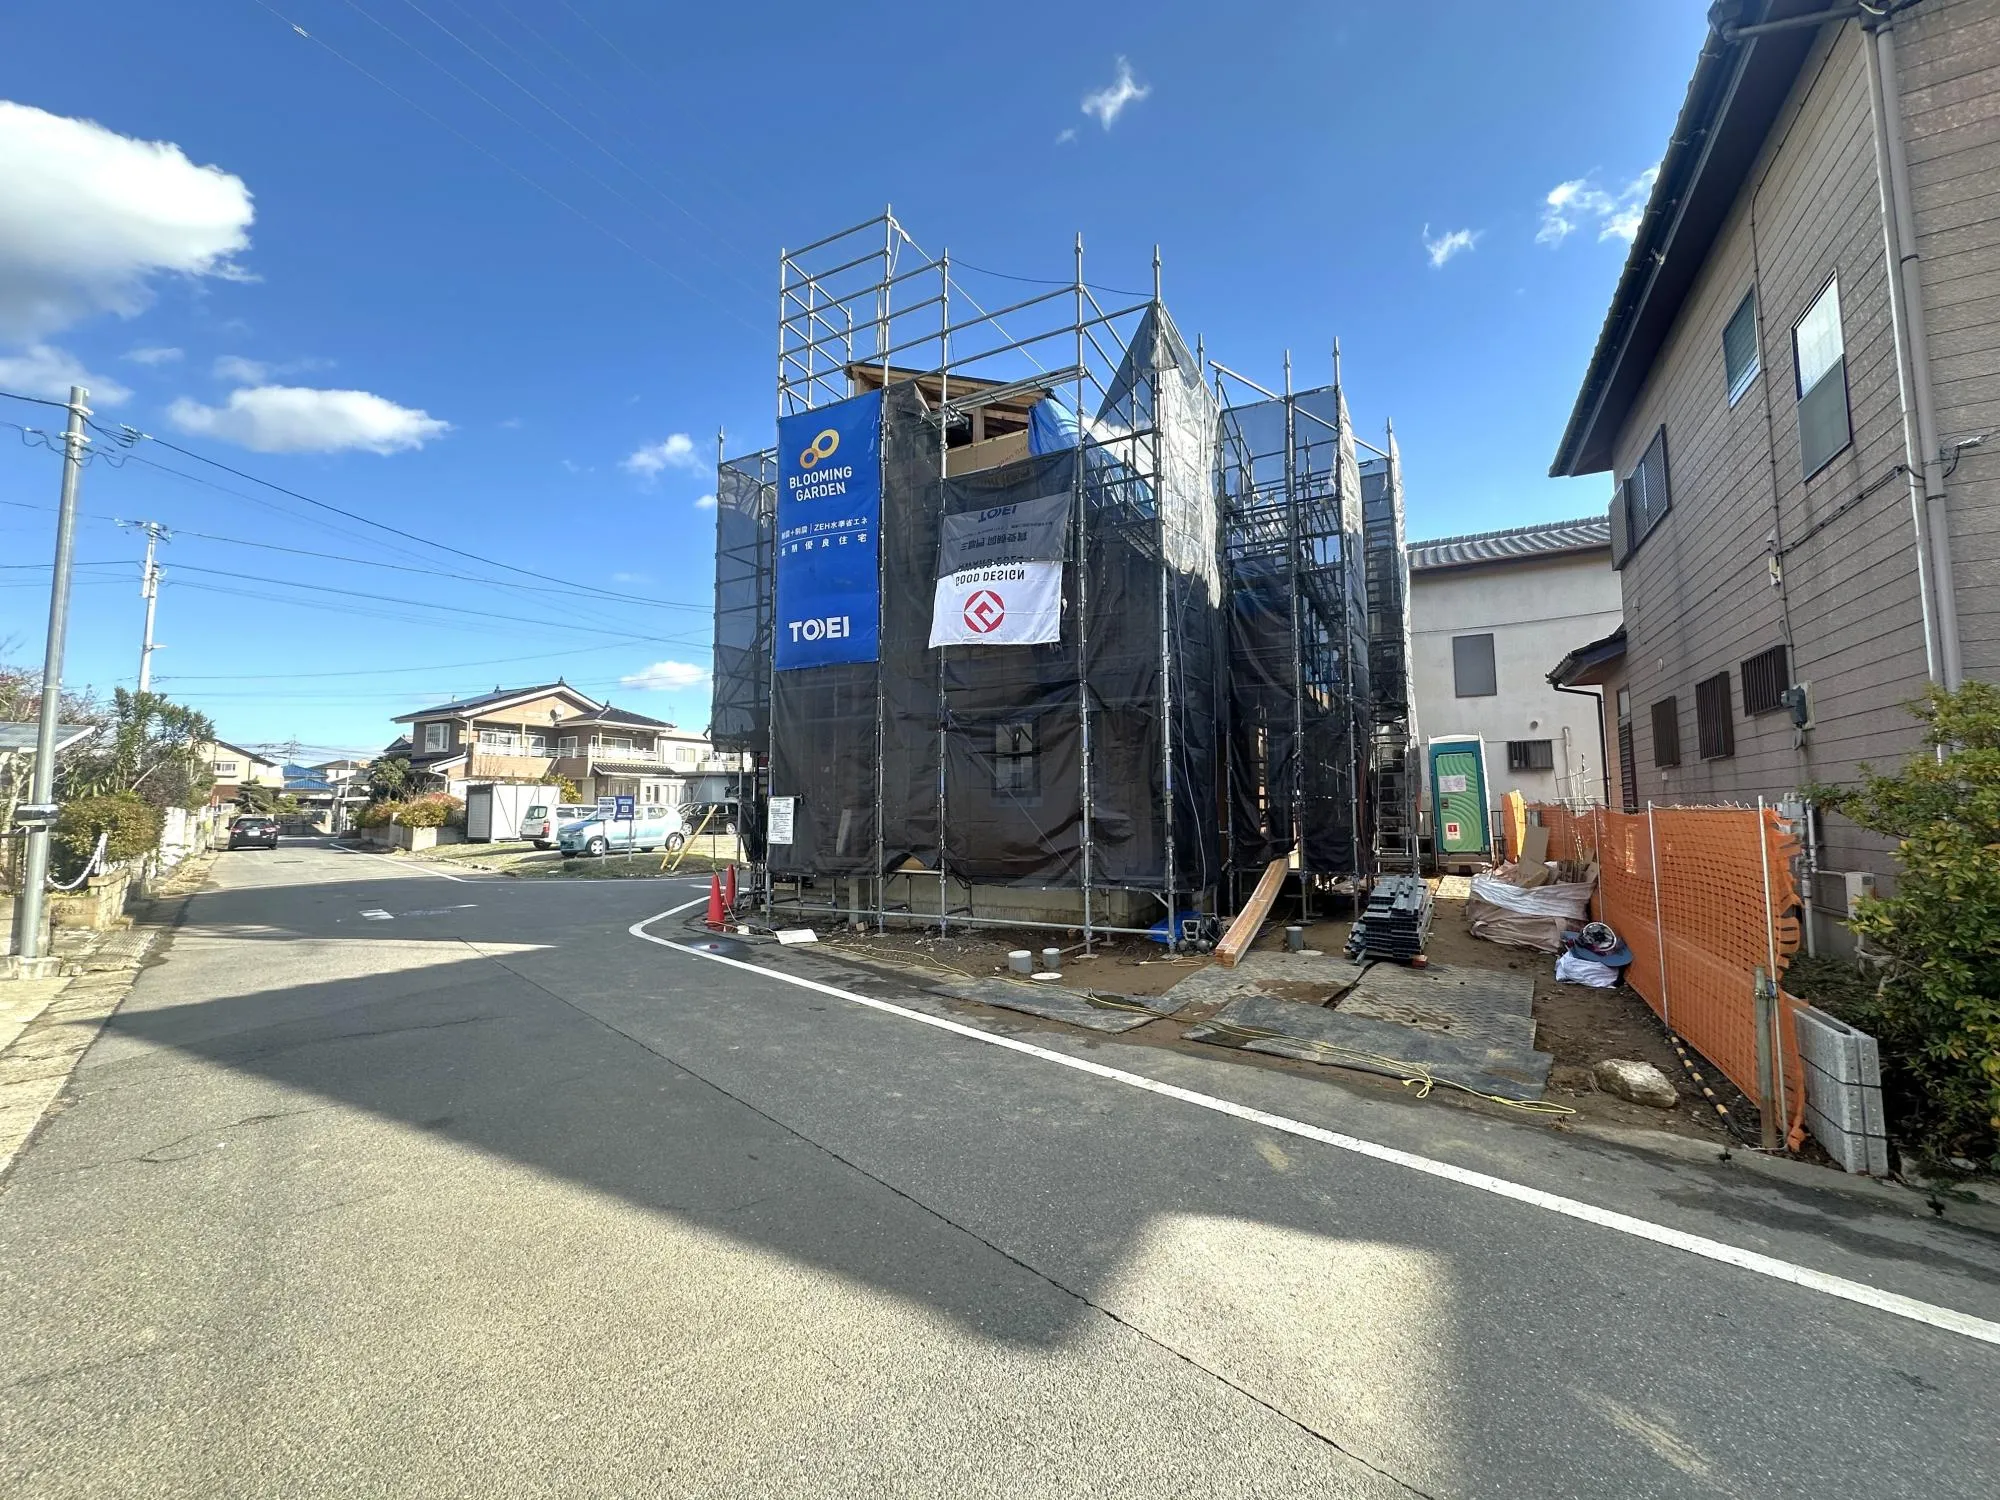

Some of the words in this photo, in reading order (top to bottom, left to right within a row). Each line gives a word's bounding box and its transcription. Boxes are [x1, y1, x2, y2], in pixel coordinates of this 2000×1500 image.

[789, 466, 852, 489] BLOOMING
[796, 481, 846, 502] GARDEN
[788, 616, 850, 642] TOEI
